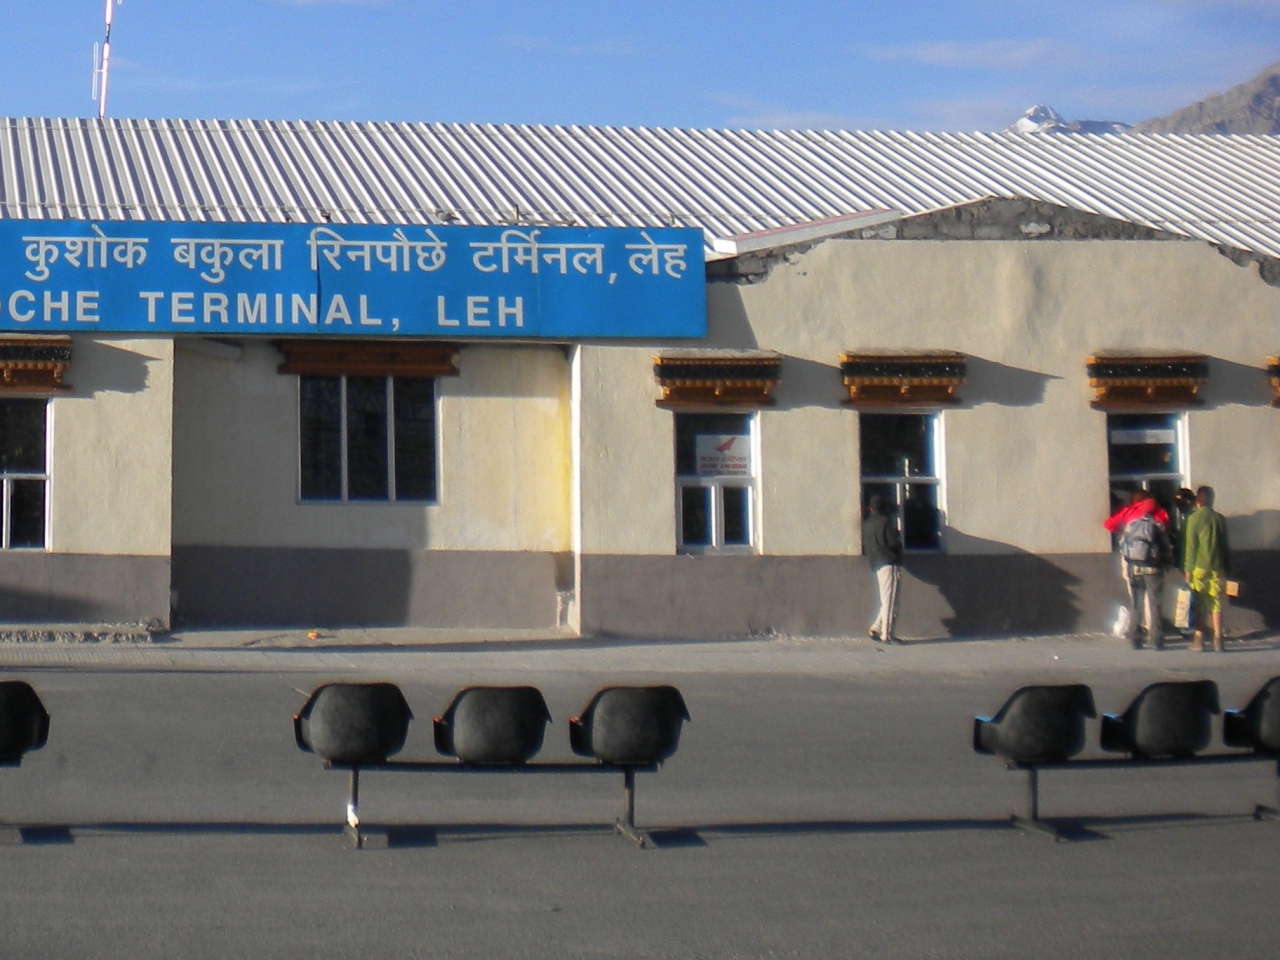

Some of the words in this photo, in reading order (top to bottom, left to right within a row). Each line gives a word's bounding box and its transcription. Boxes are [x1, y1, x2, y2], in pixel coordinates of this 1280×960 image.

[21, 223, 150, 283] कुशोक
[170, 237, 285, 284] बकुला
[306, 226, 449, 272] रिनपौछे
[468, 229, 617, 285] टर्मिनल,
[624, 231, 688, 279] लेह
[139, 291, 400, 332] TERMINAL,
[437, 295, 524, 328] LEH
